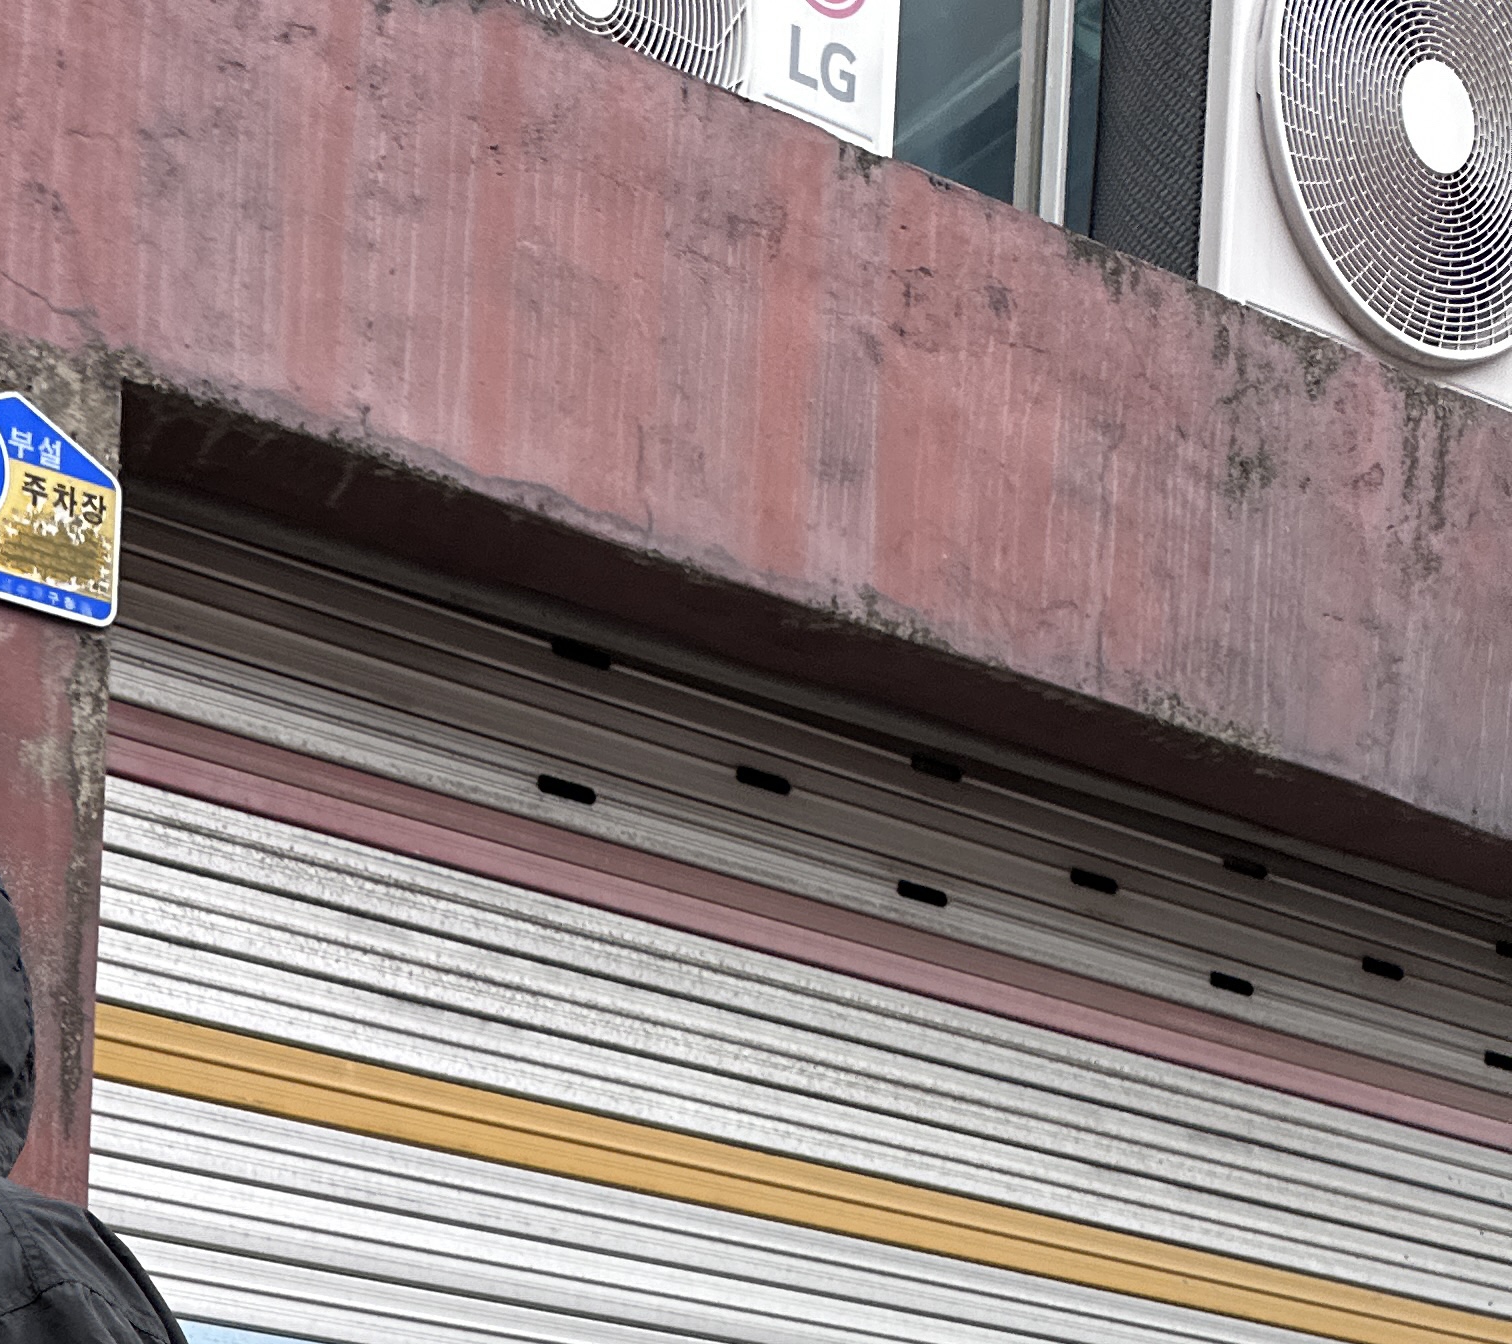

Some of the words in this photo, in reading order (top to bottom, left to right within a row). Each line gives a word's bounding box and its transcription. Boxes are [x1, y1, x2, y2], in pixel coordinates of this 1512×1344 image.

[789, 24, 857, 102] LG
[8, 427, 62, 470] 부설
[21, 472, 107, 525] 주차장
